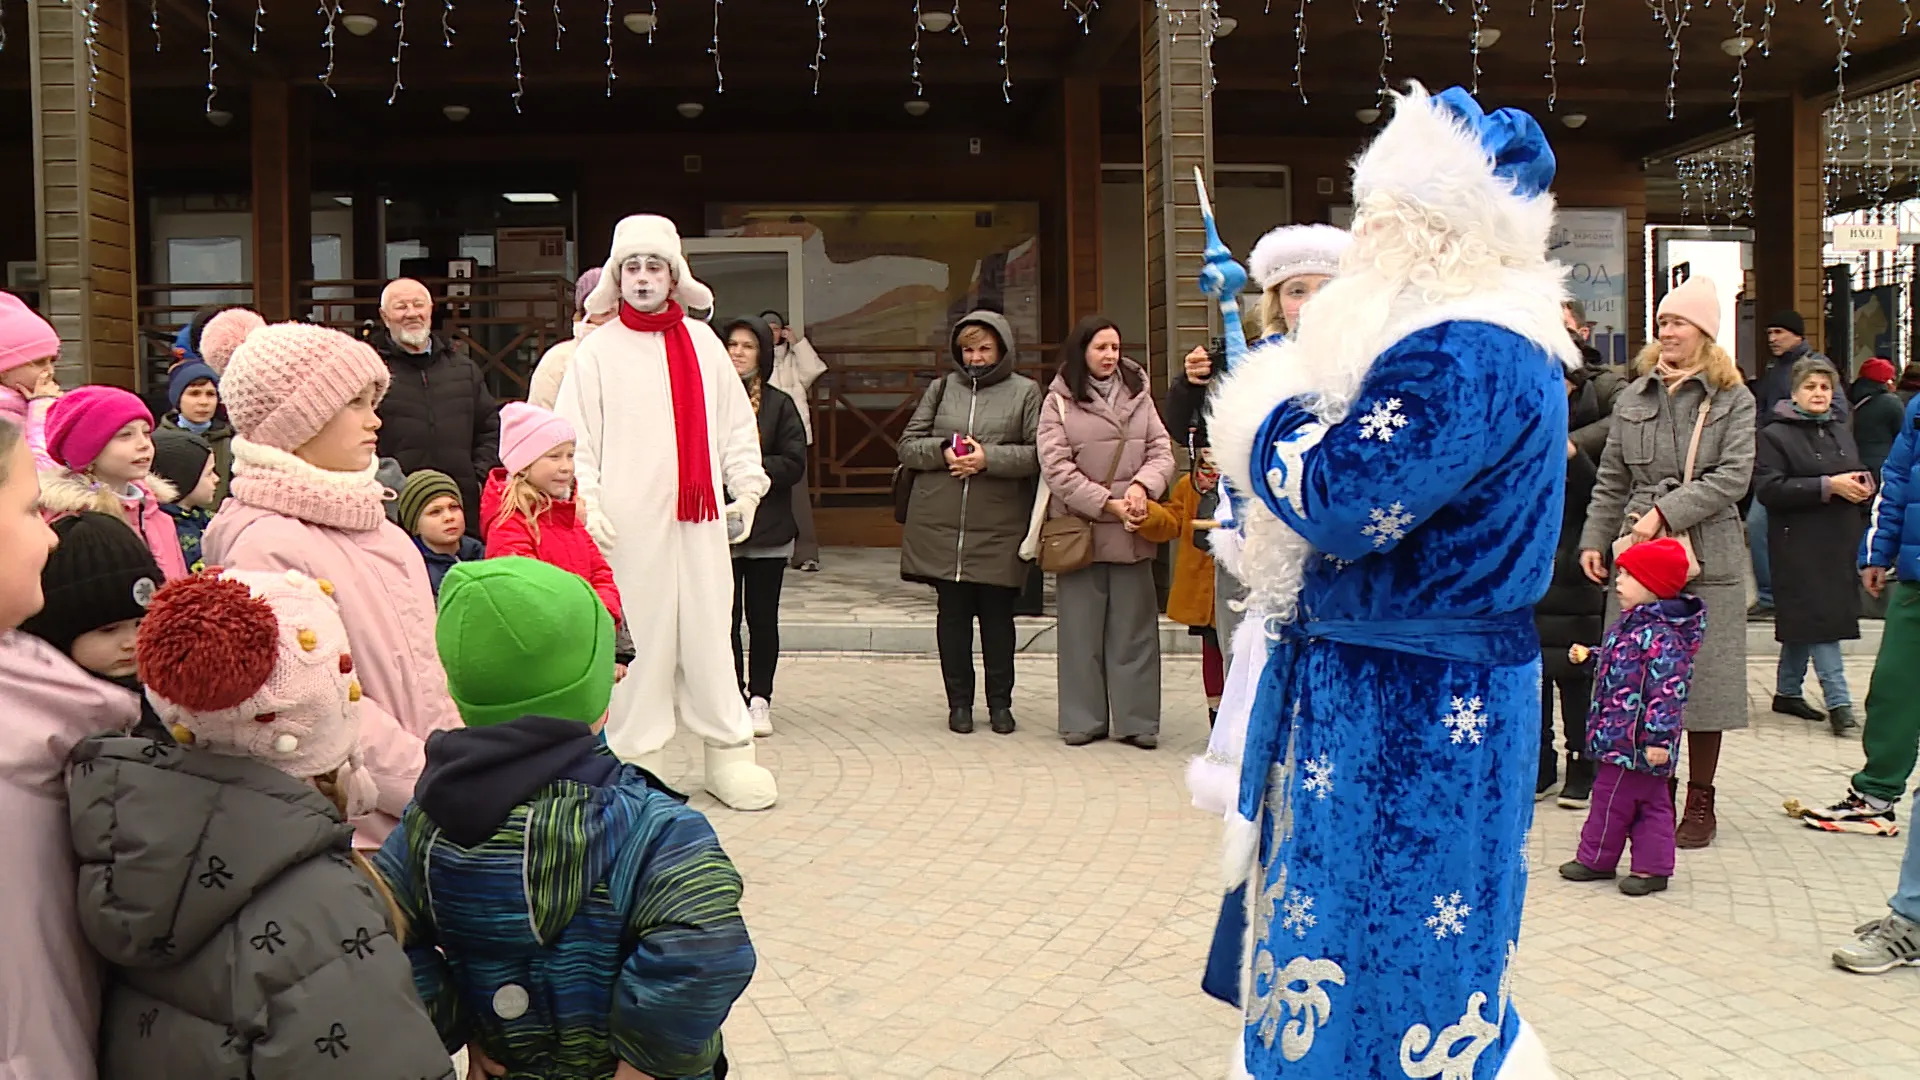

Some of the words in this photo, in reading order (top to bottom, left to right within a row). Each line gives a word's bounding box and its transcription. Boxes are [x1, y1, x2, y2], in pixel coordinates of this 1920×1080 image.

[1850, 229, 1883, 239] ВХОД
[1571, 263, 1612, 287] ОД
[1584, 297, 1615, 311] ИЙ!
